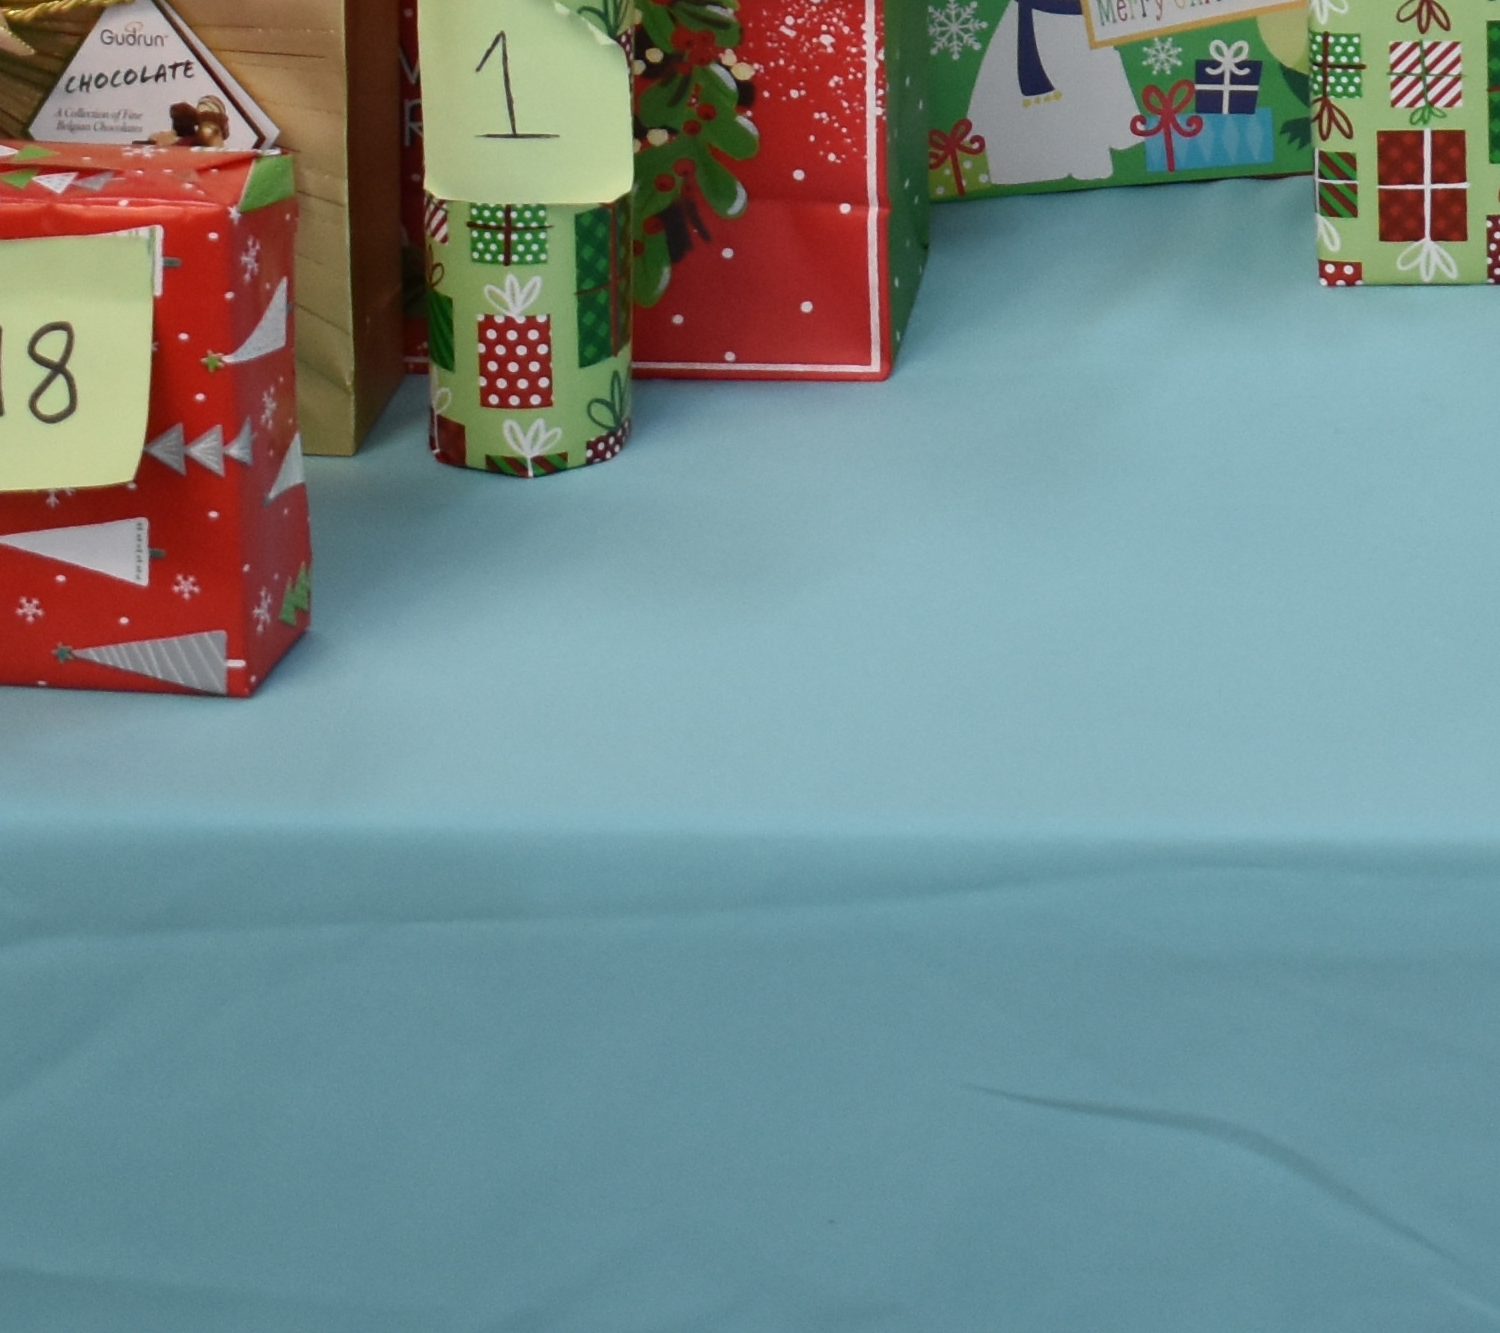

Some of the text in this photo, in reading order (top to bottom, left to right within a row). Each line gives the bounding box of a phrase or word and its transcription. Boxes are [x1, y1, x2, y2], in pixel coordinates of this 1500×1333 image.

[100, 26, 165, 47] Gudrun
[65, 59, 196, 94] CHOCOLATE
[475, 30, 560, 140] 1
